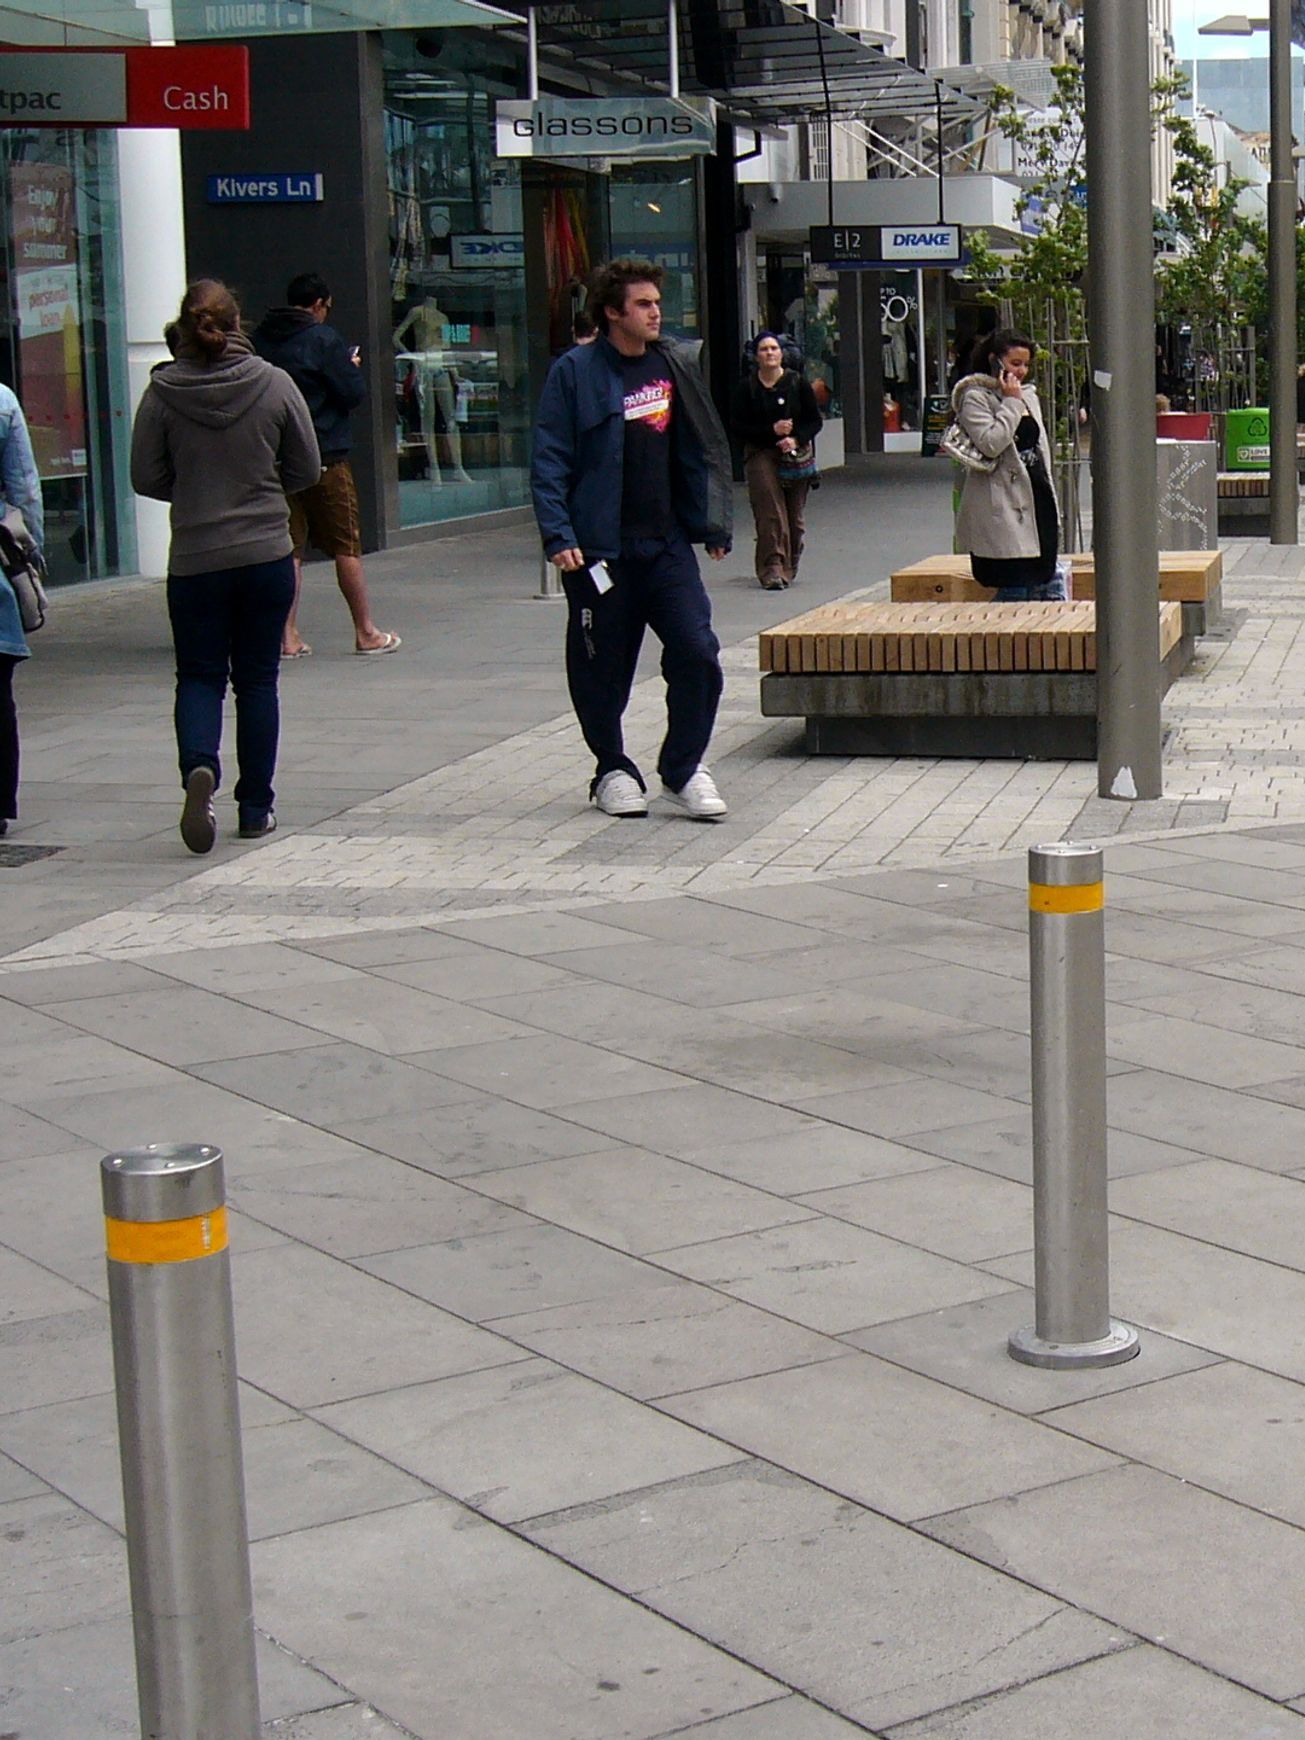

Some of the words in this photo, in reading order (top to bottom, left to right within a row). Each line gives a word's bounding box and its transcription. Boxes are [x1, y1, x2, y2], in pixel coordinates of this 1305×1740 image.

[163, 85, 229, 111] Cash
[217, 178, 279, 197] Kivers
[286, 177, 311, 196] Ln
[893, 232, 951, 246] DRAKE
